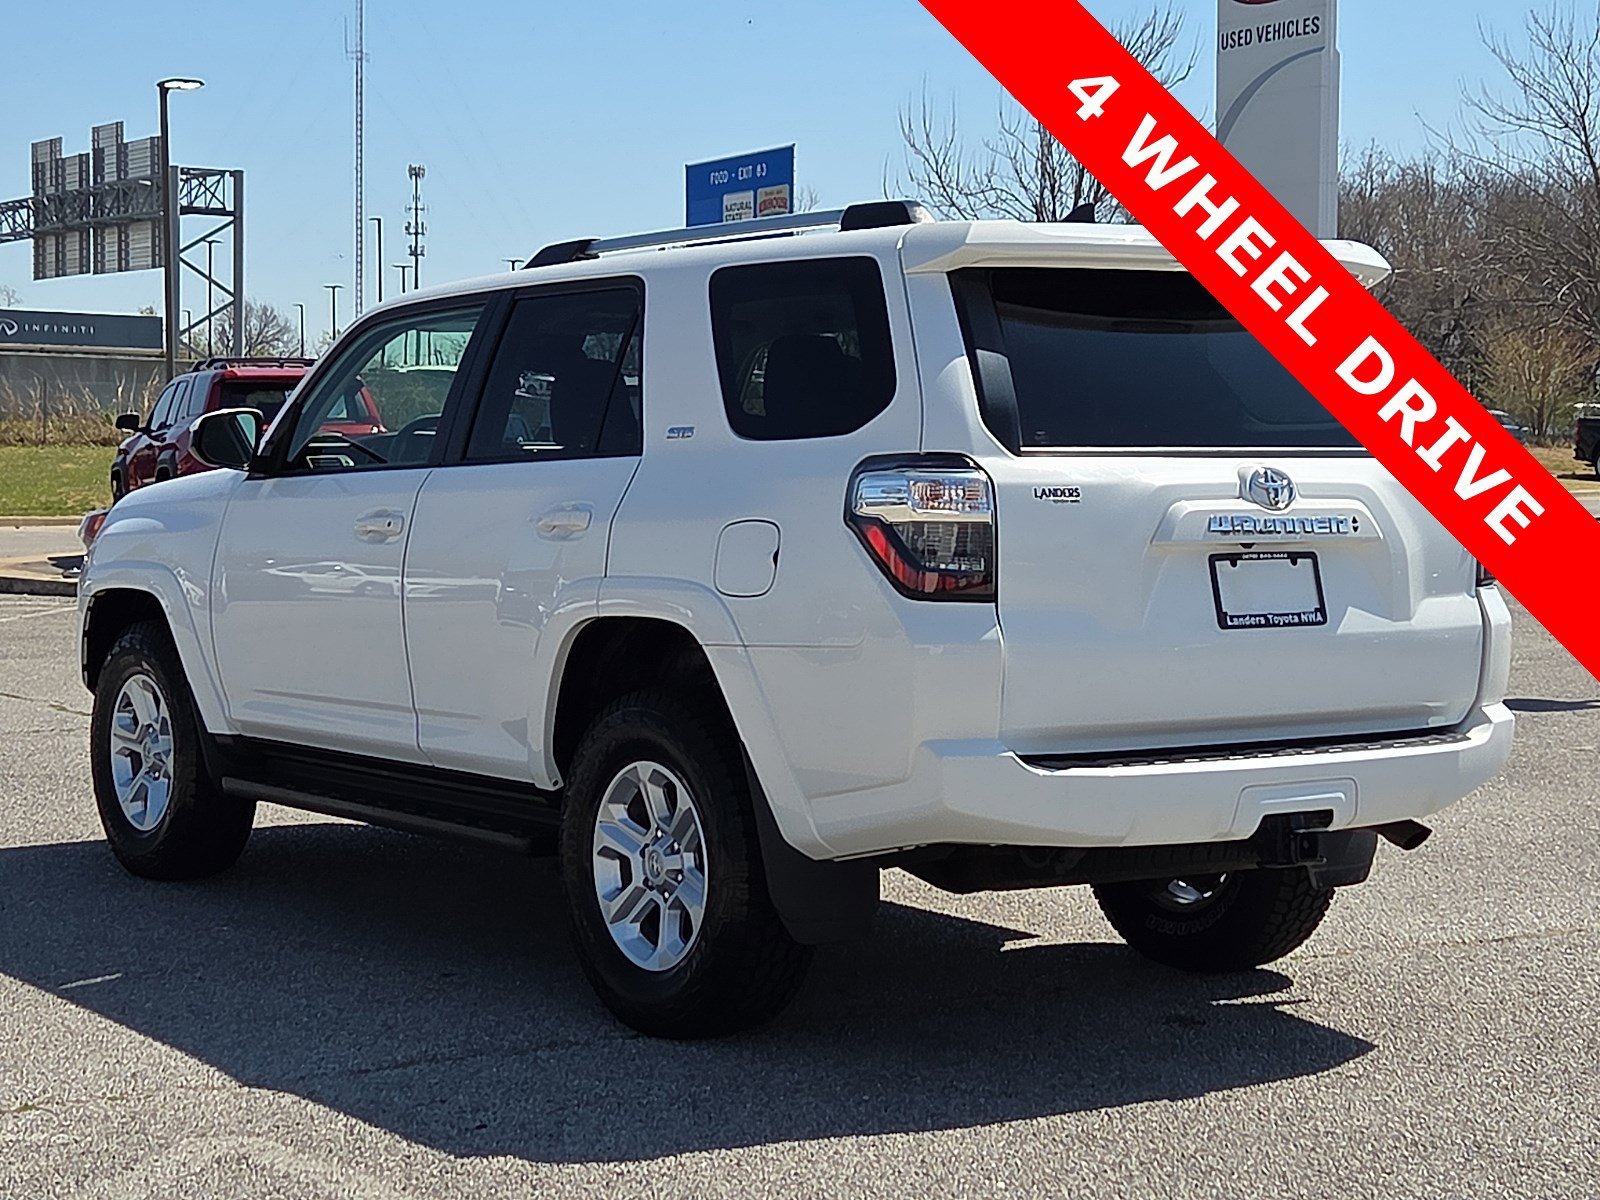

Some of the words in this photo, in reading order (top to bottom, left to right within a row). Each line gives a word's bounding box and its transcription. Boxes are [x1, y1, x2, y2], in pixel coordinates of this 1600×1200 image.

[1221, 28, 1252, 50] USED
[1256, 15, 1320, 43] VEHICLES
[710, 170, 729, 185] FOOD
[738, 165, 753, 180] EXIT
[24, 323, 95, 335] INFINITI
[1033, 487, 1081, 499] LANDERS
[1227, 614, 1266, 626] Landers
[1267, 613, 1299, 626] Toyota
[1300, 611, 1324, 623] NWA
